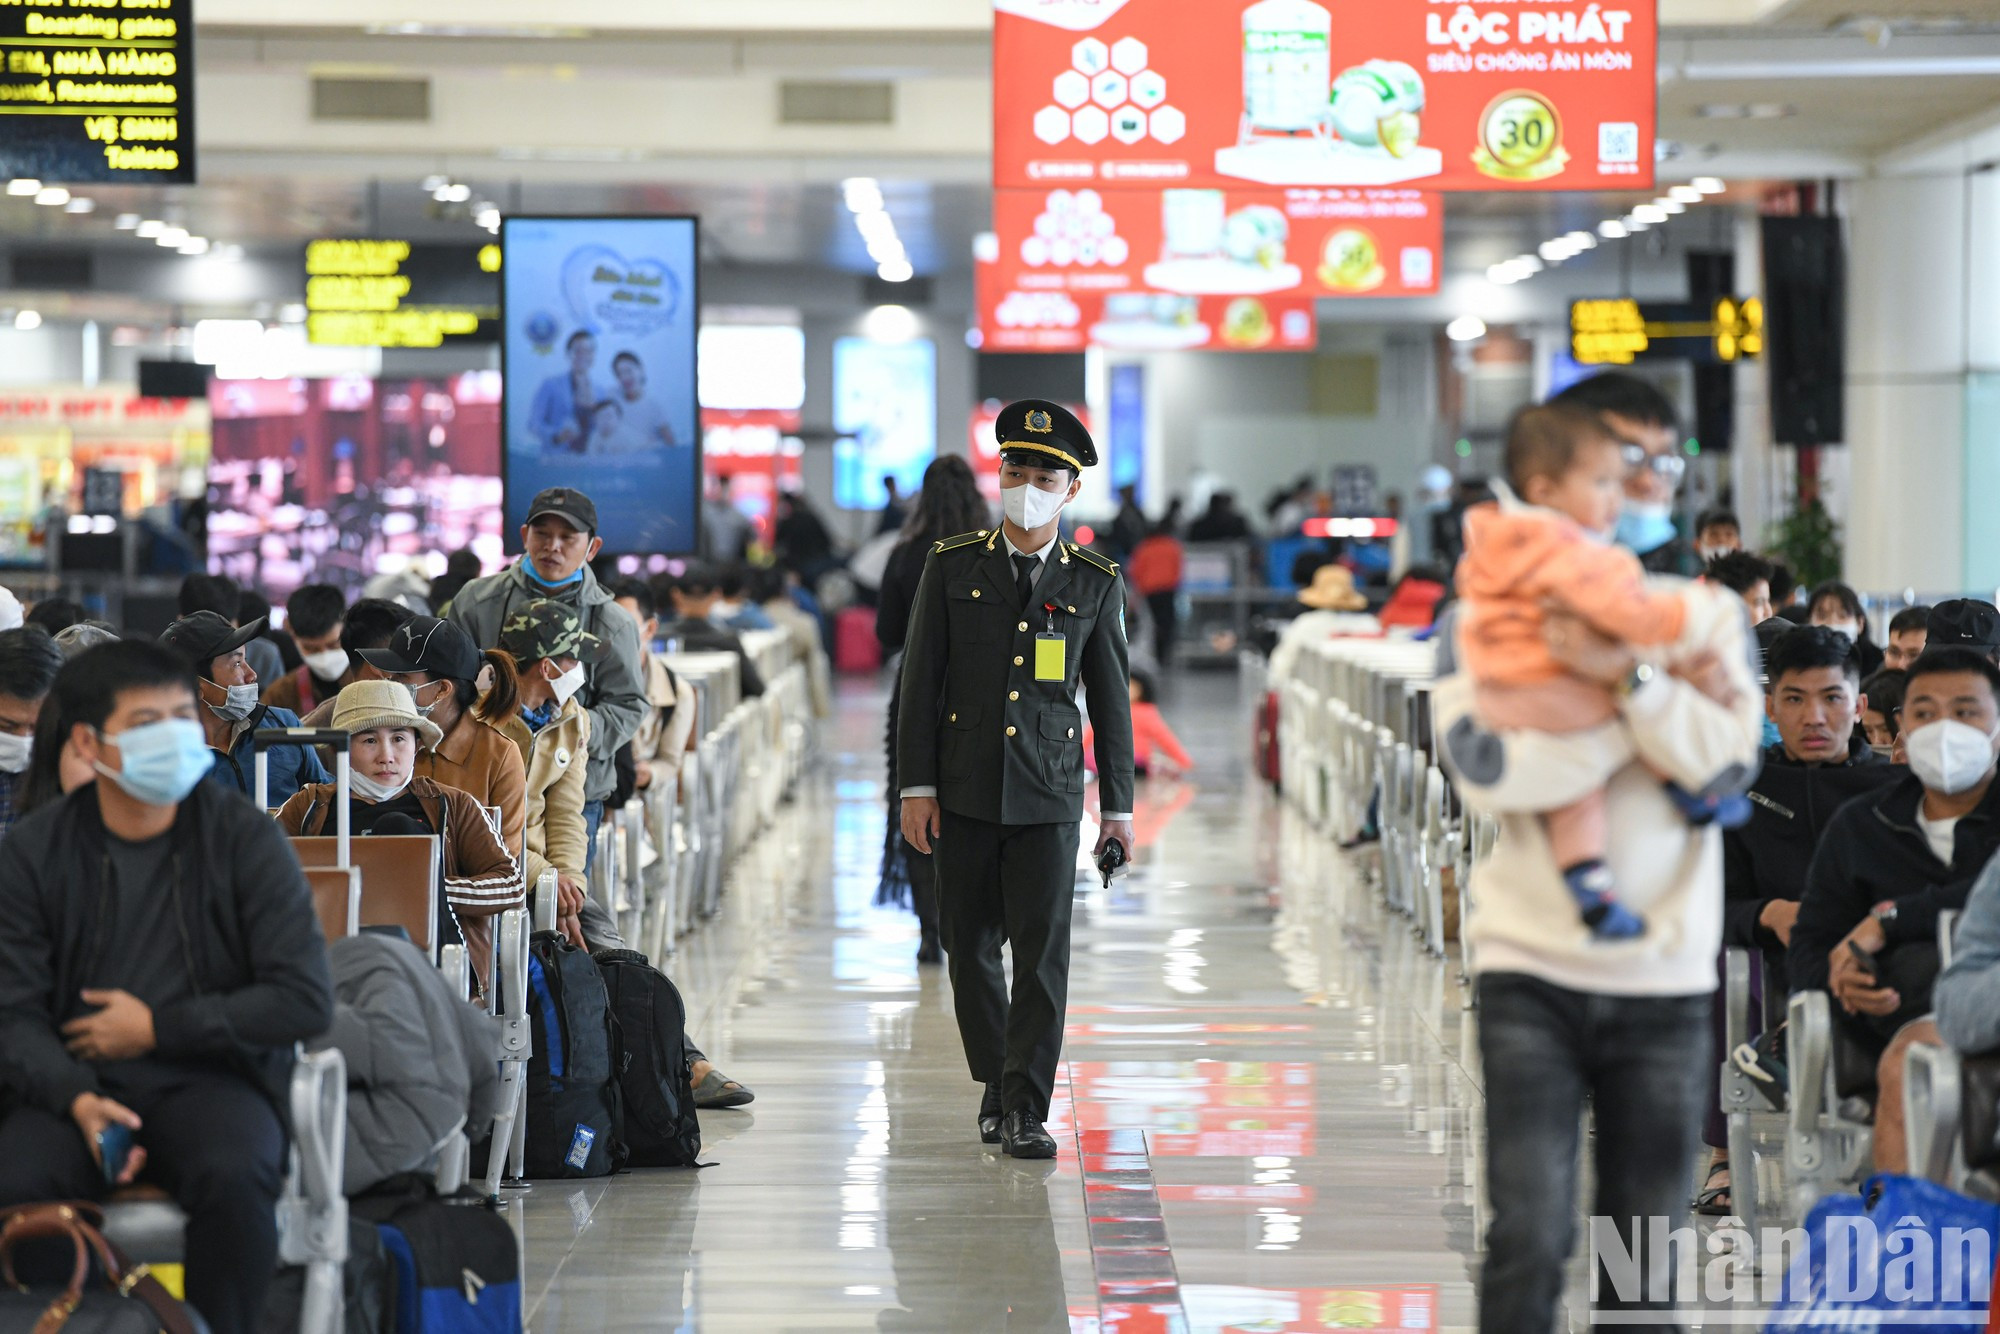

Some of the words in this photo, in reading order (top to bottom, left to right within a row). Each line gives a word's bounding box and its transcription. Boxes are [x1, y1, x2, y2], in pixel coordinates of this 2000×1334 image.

[1426, 4, 1511, 51] LỘC
[1518, 3, 1632, 44] PHÁT
[1500, 119, 1543, 148] 30
